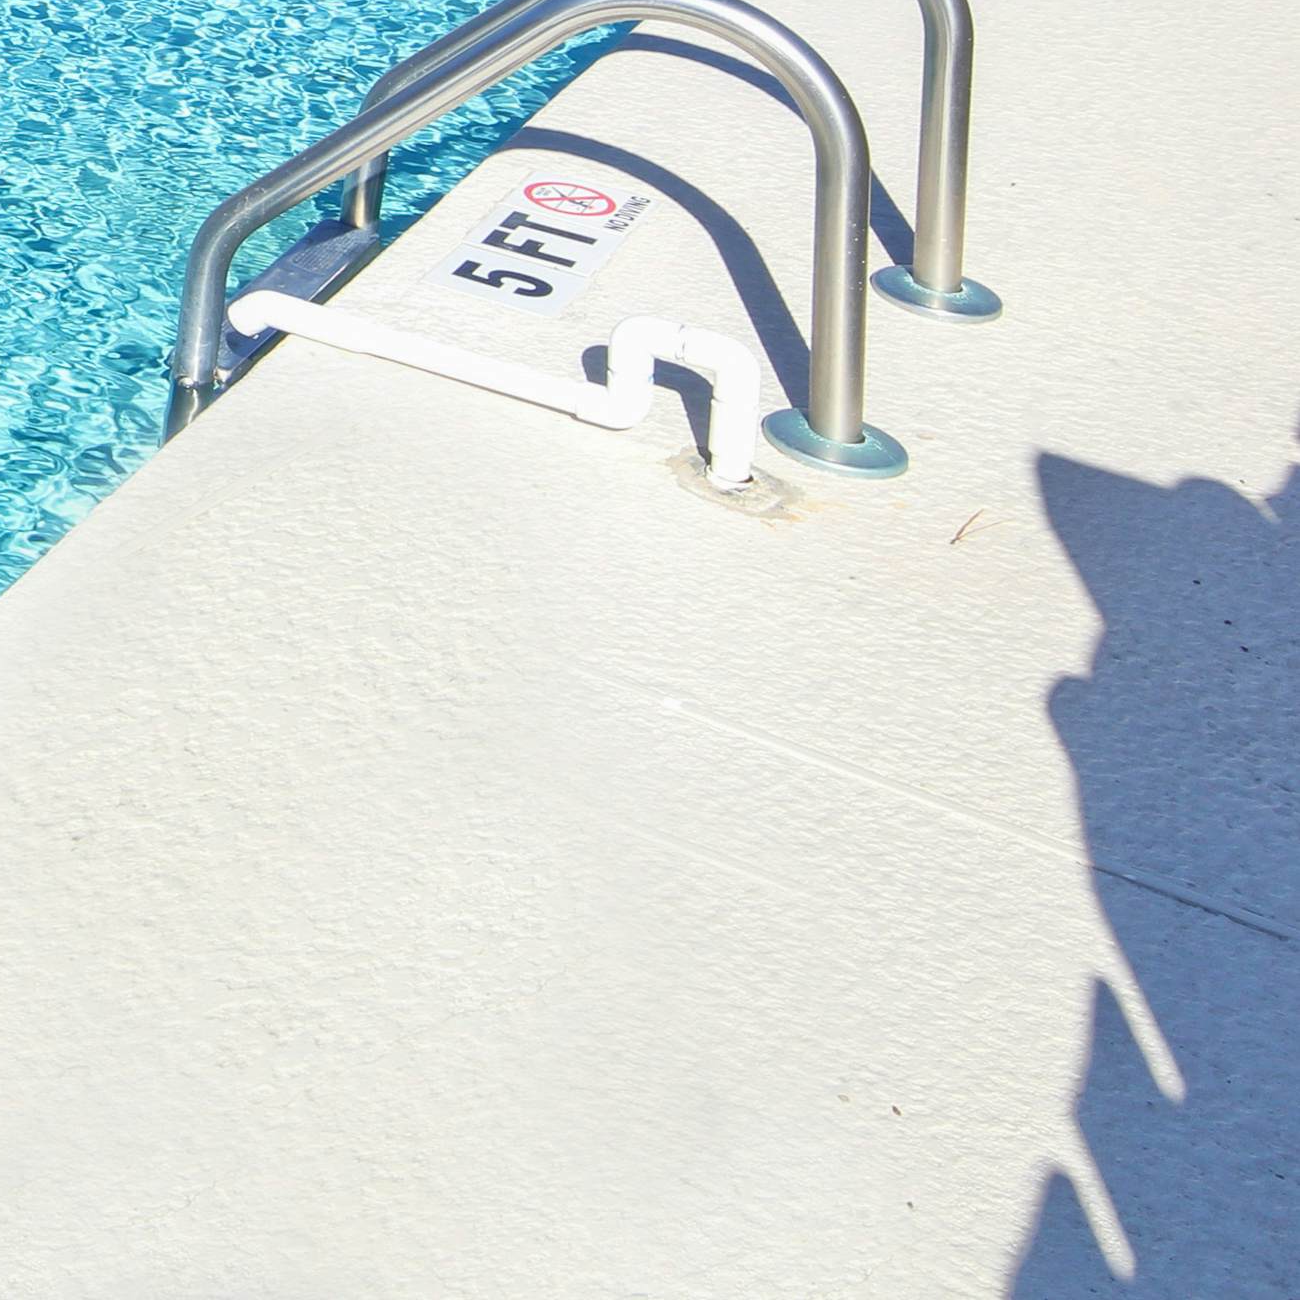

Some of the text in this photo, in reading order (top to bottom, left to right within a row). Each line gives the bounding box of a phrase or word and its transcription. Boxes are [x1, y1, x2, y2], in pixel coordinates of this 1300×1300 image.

[602, 196, 651, 233] NO DIVING
[451, 210, 598, 298] 5 FT
